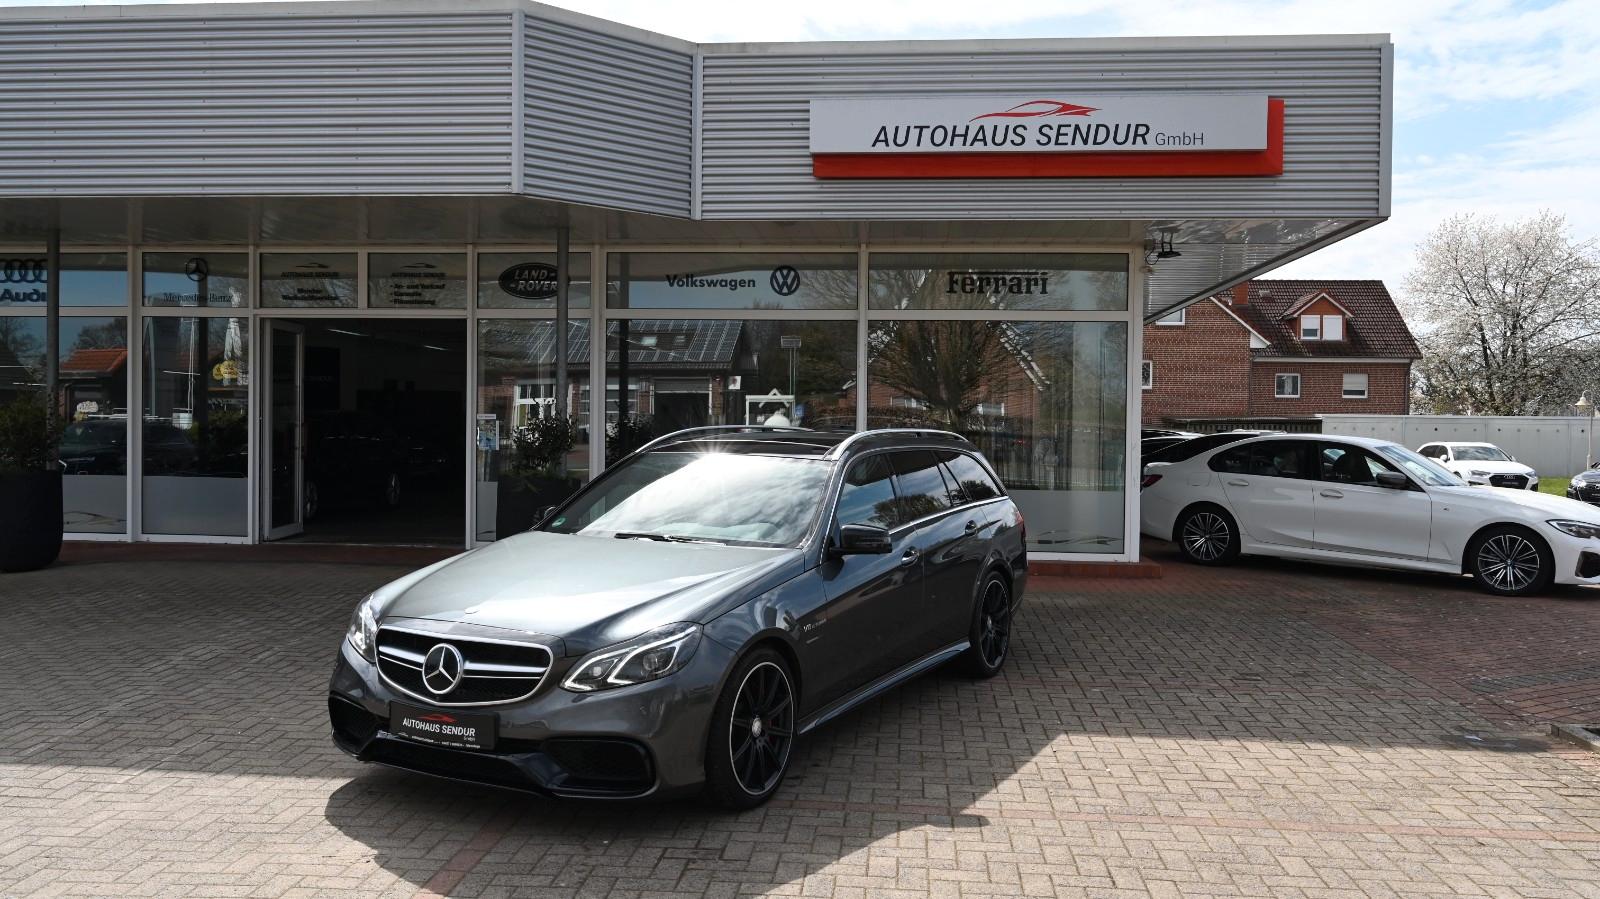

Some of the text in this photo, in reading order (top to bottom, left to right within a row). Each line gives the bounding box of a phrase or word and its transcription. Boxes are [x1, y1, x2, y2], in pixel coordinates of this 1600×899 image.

[871, 122, 1204, 148] AUTOHAUS SENDUR GmbH
[665, 274, 756, 291] Volkswagen
[945, 271, 1049, 295] Ferrari
[0, 288, 47, 302] Audi
[402, 717, 476, 737] AUTOHAUS SENDUR
